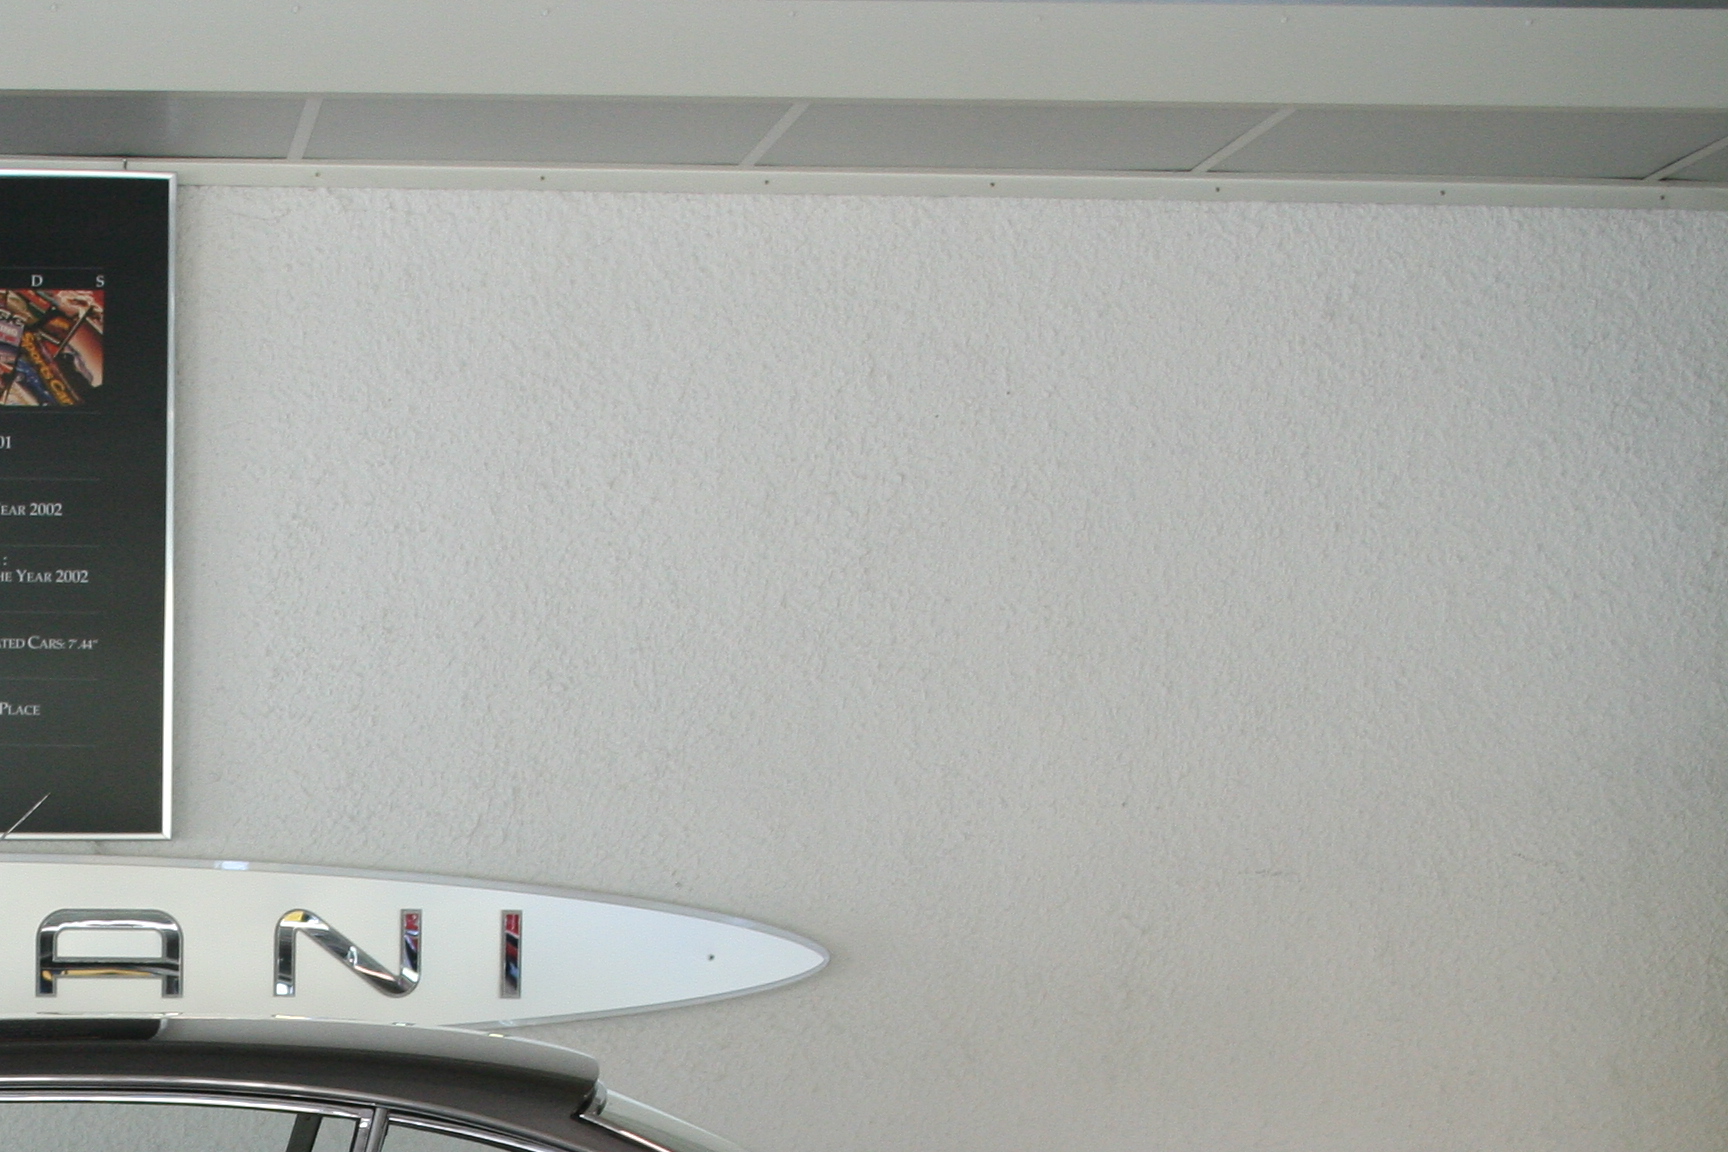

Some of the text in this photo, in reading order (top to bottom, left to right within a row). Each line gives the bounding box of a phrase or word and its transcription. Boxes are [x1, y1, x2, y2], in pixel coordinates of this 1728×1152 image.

[29, 502, 63, 517] 2002
[15, 568, 53, 583] YEAR
[55, 568, 89, 584] 2002
